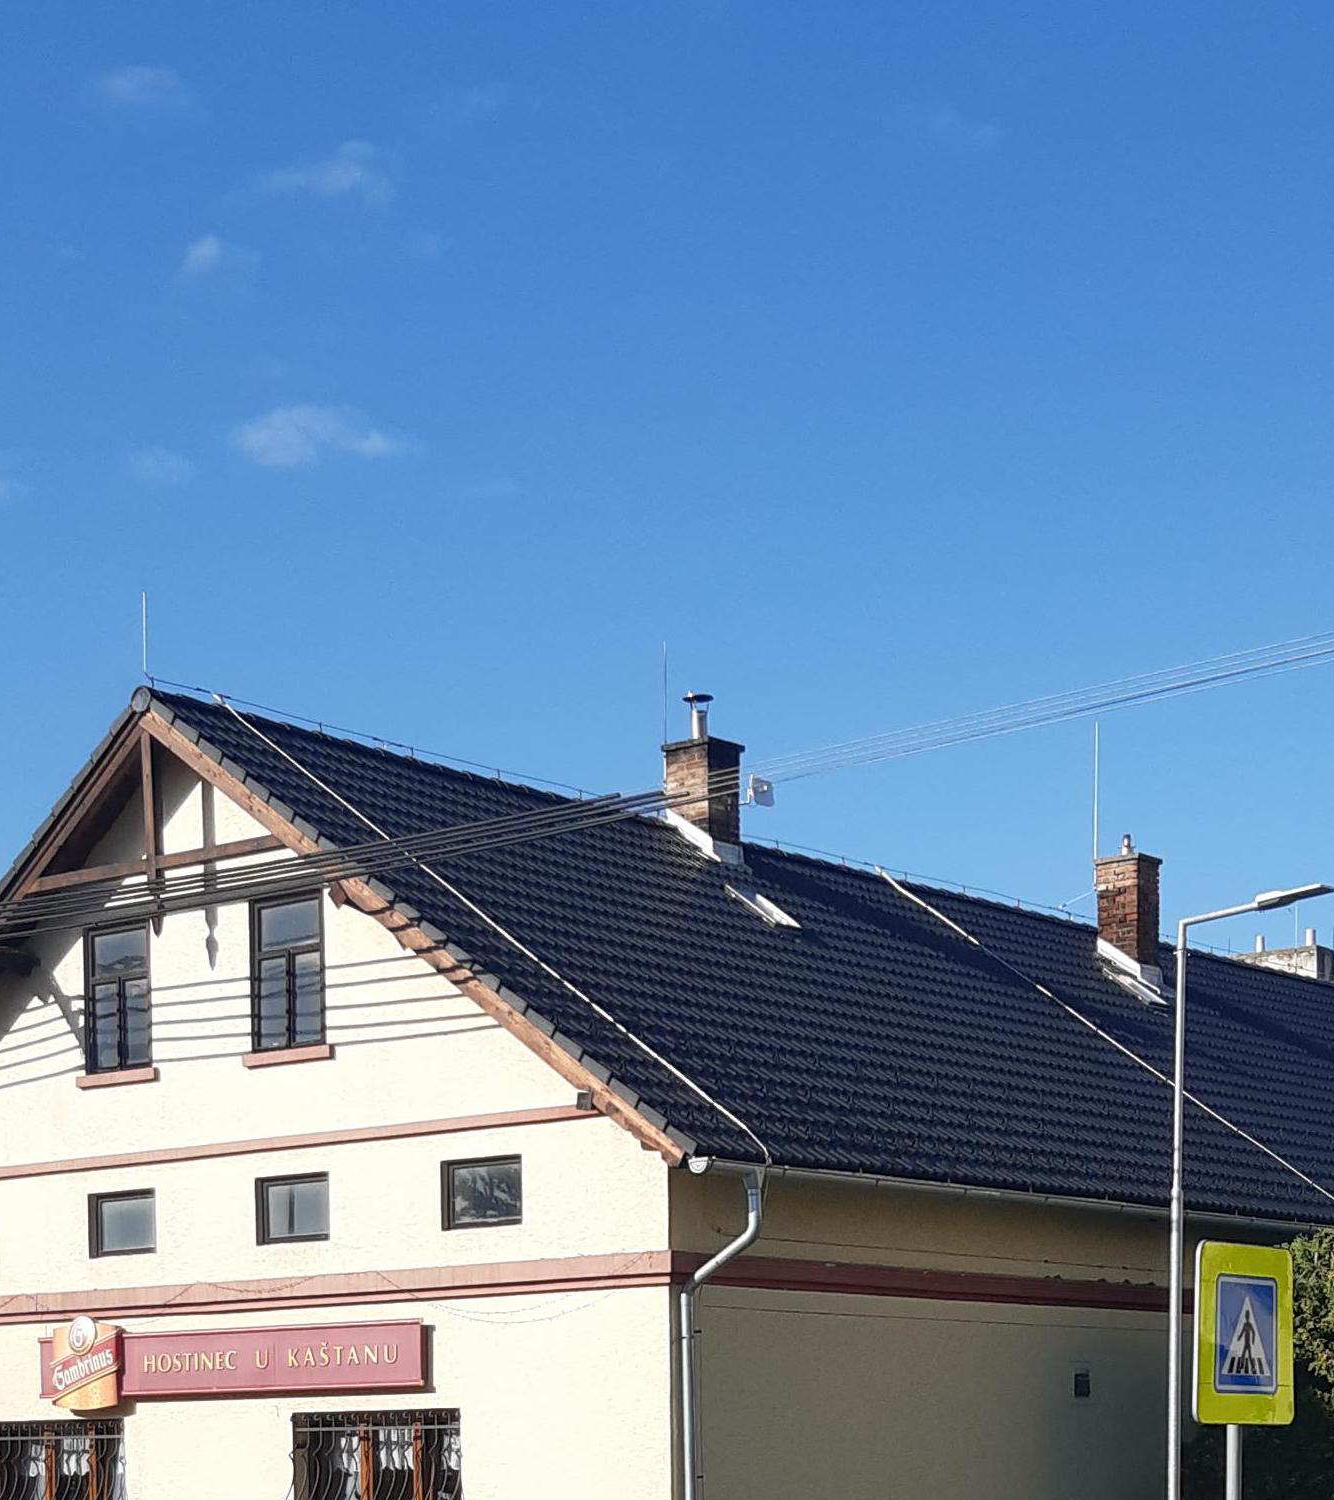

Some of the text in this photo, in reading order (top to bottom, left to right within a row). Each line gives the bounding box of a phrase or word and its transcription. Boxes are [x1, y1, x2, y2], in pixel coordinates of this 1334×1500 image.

[52, 1349, 113, 1390] Gambrinus
[143, 1341, 399, 1373] HOSTINEC U KAŠTANU
